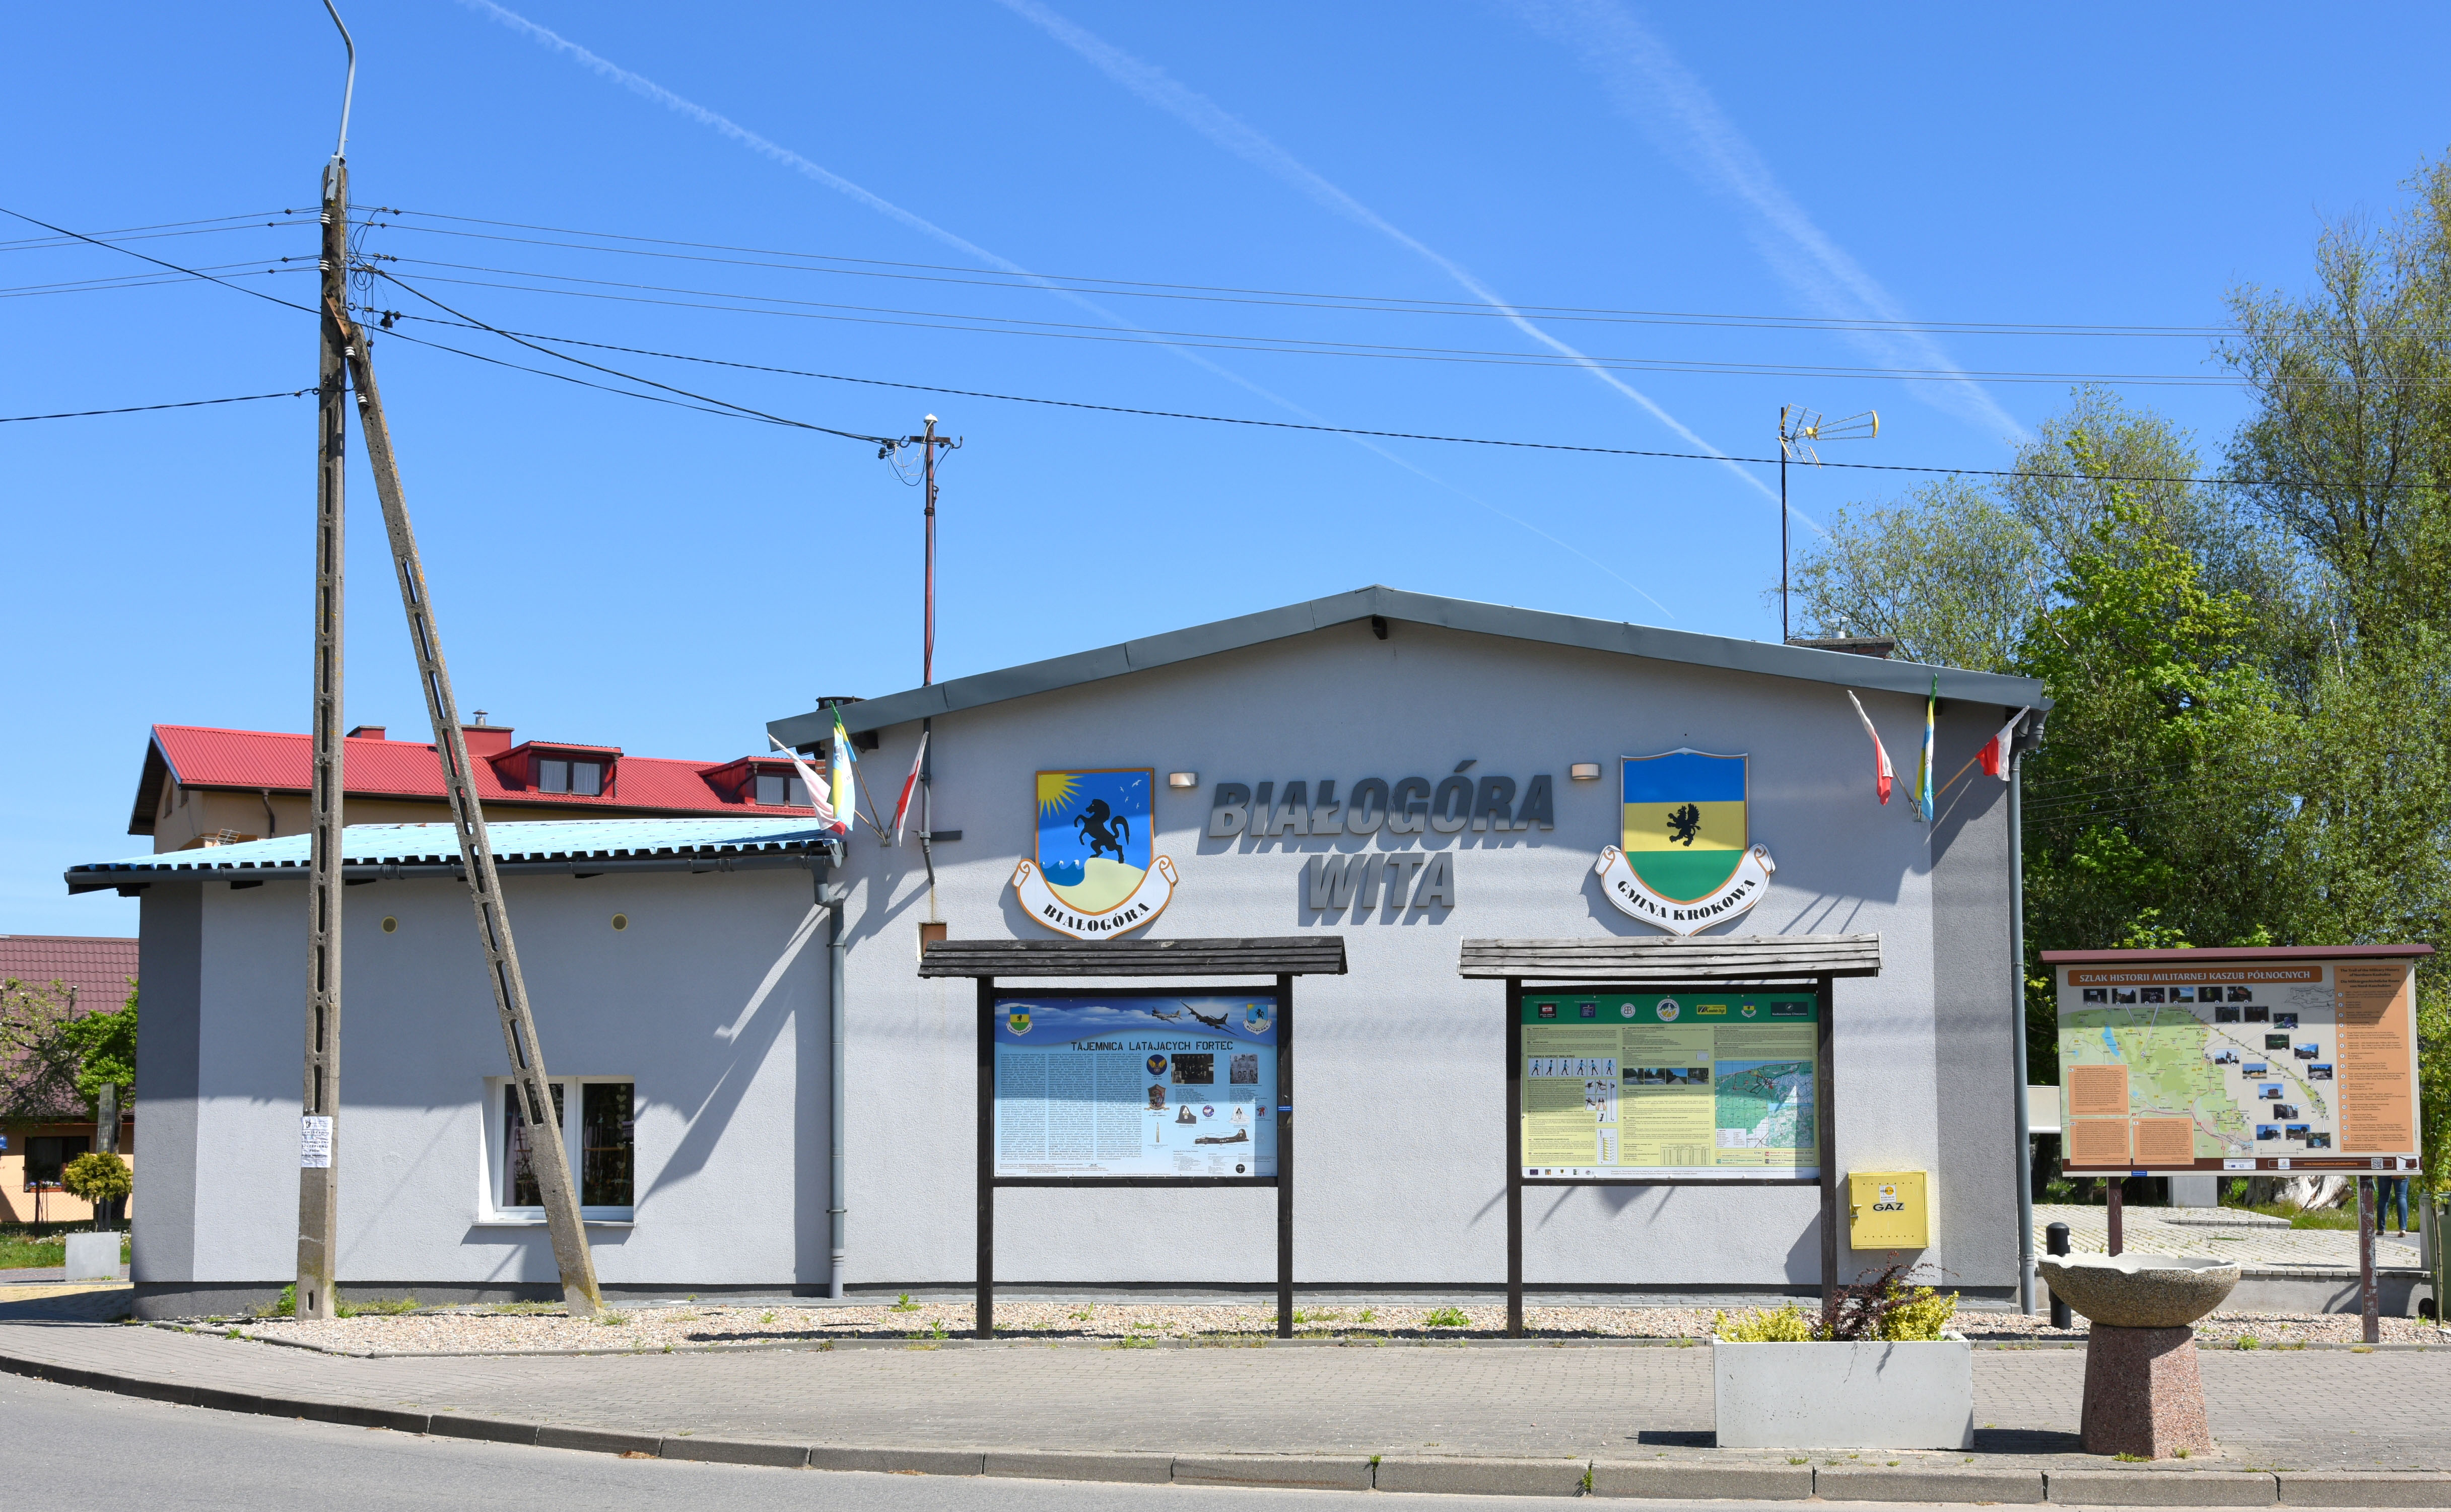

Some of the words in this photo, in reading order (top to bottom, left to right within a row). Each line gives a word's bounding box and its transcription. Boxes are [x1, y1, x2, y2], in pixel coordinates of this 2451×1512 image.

[1209, 760, 1554, 837] BIAŁOGÓRA
[1310, 852, 1455, 909] WITA
[1618, 880, 1667, 918] GMINA
[1673, 879, 1756, 920] KROKOWA
[1043, 902, 1150, 932] BIAŁOGÓRA
[2080, 974, 2107, 982] SZLAK
[2110, 974, 2149, 982] HISTORII
[2152, 973, 2207, 981] MILITARNEJ
[2209, 972, 2244, 980] KASZUB
[2248, 970, 2310, 980] PÓŁNOCNYCH
[1071, 1041, 1124, 1051] TAJEMNICA
[1129, 1041, 1190, 1052] LATAJĄCYCH
[1196, 1041, 1233, 1051] FORTEC
[1873, 1203, 1904, 1211] GAZ
